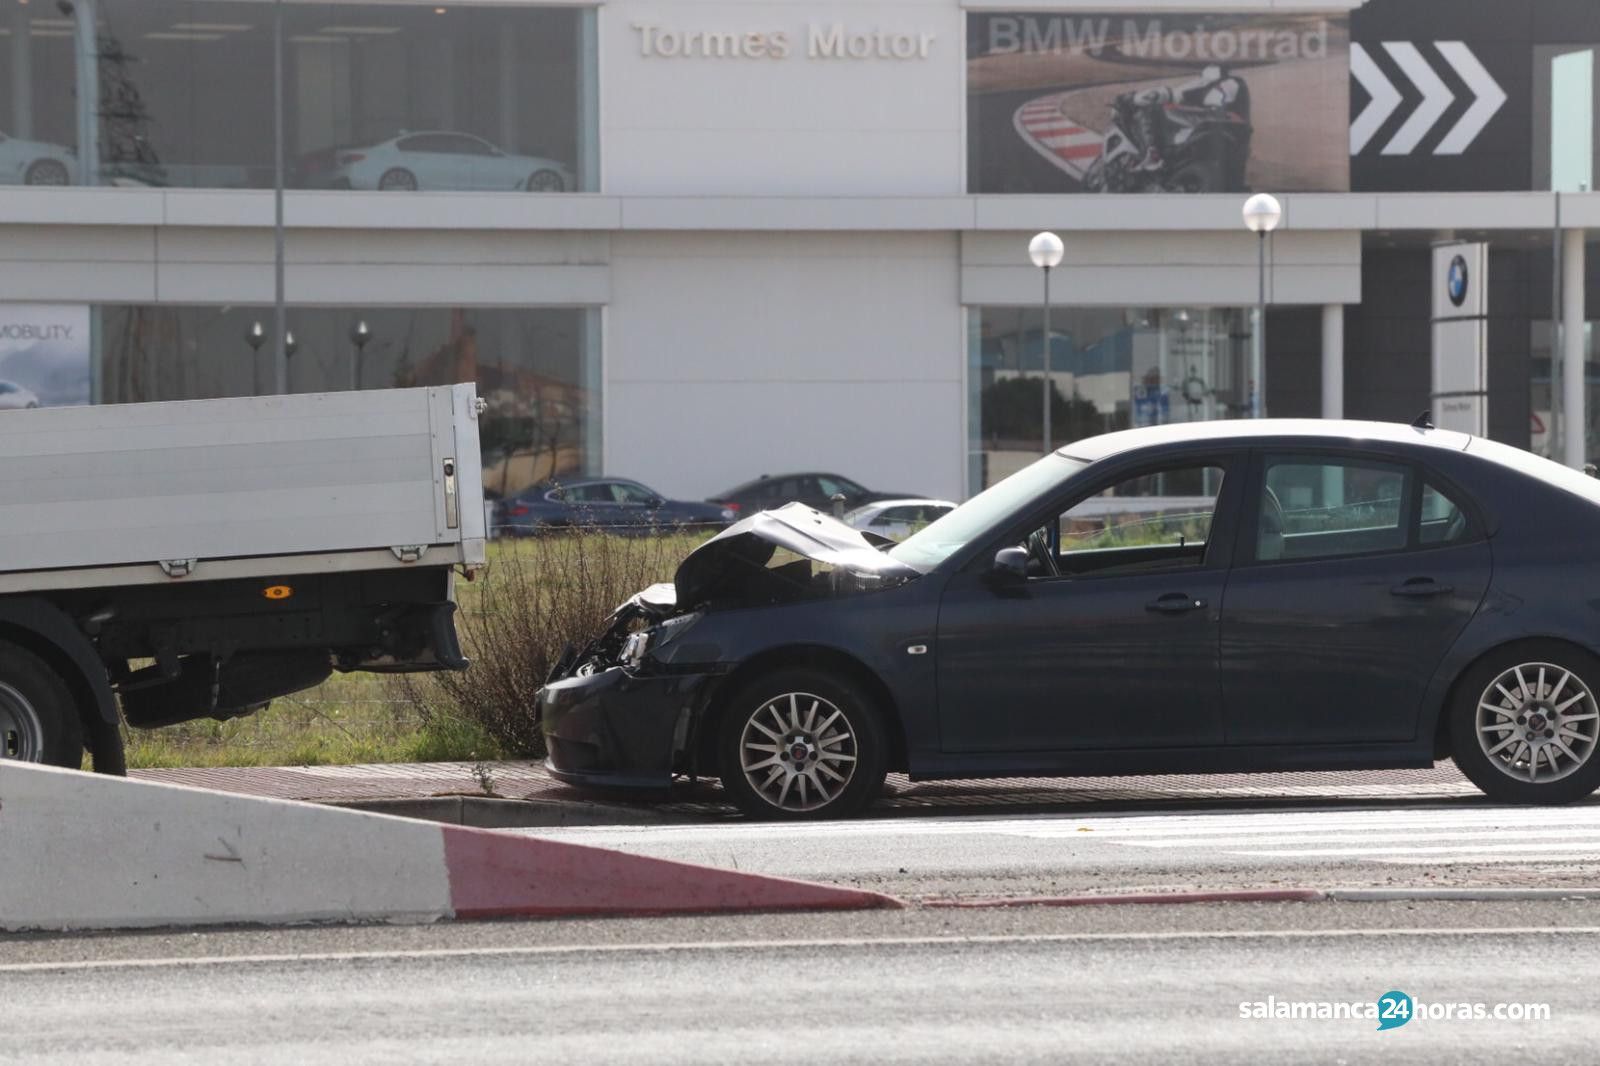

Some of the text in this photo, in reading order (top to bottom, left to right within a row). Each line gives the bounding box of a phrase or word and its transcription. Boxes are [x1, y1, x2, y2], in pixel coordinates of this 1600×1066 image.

[630, 22, 936, 59] Tormes Motor
[987, 17, 1327, 59] BMW Motorrad
